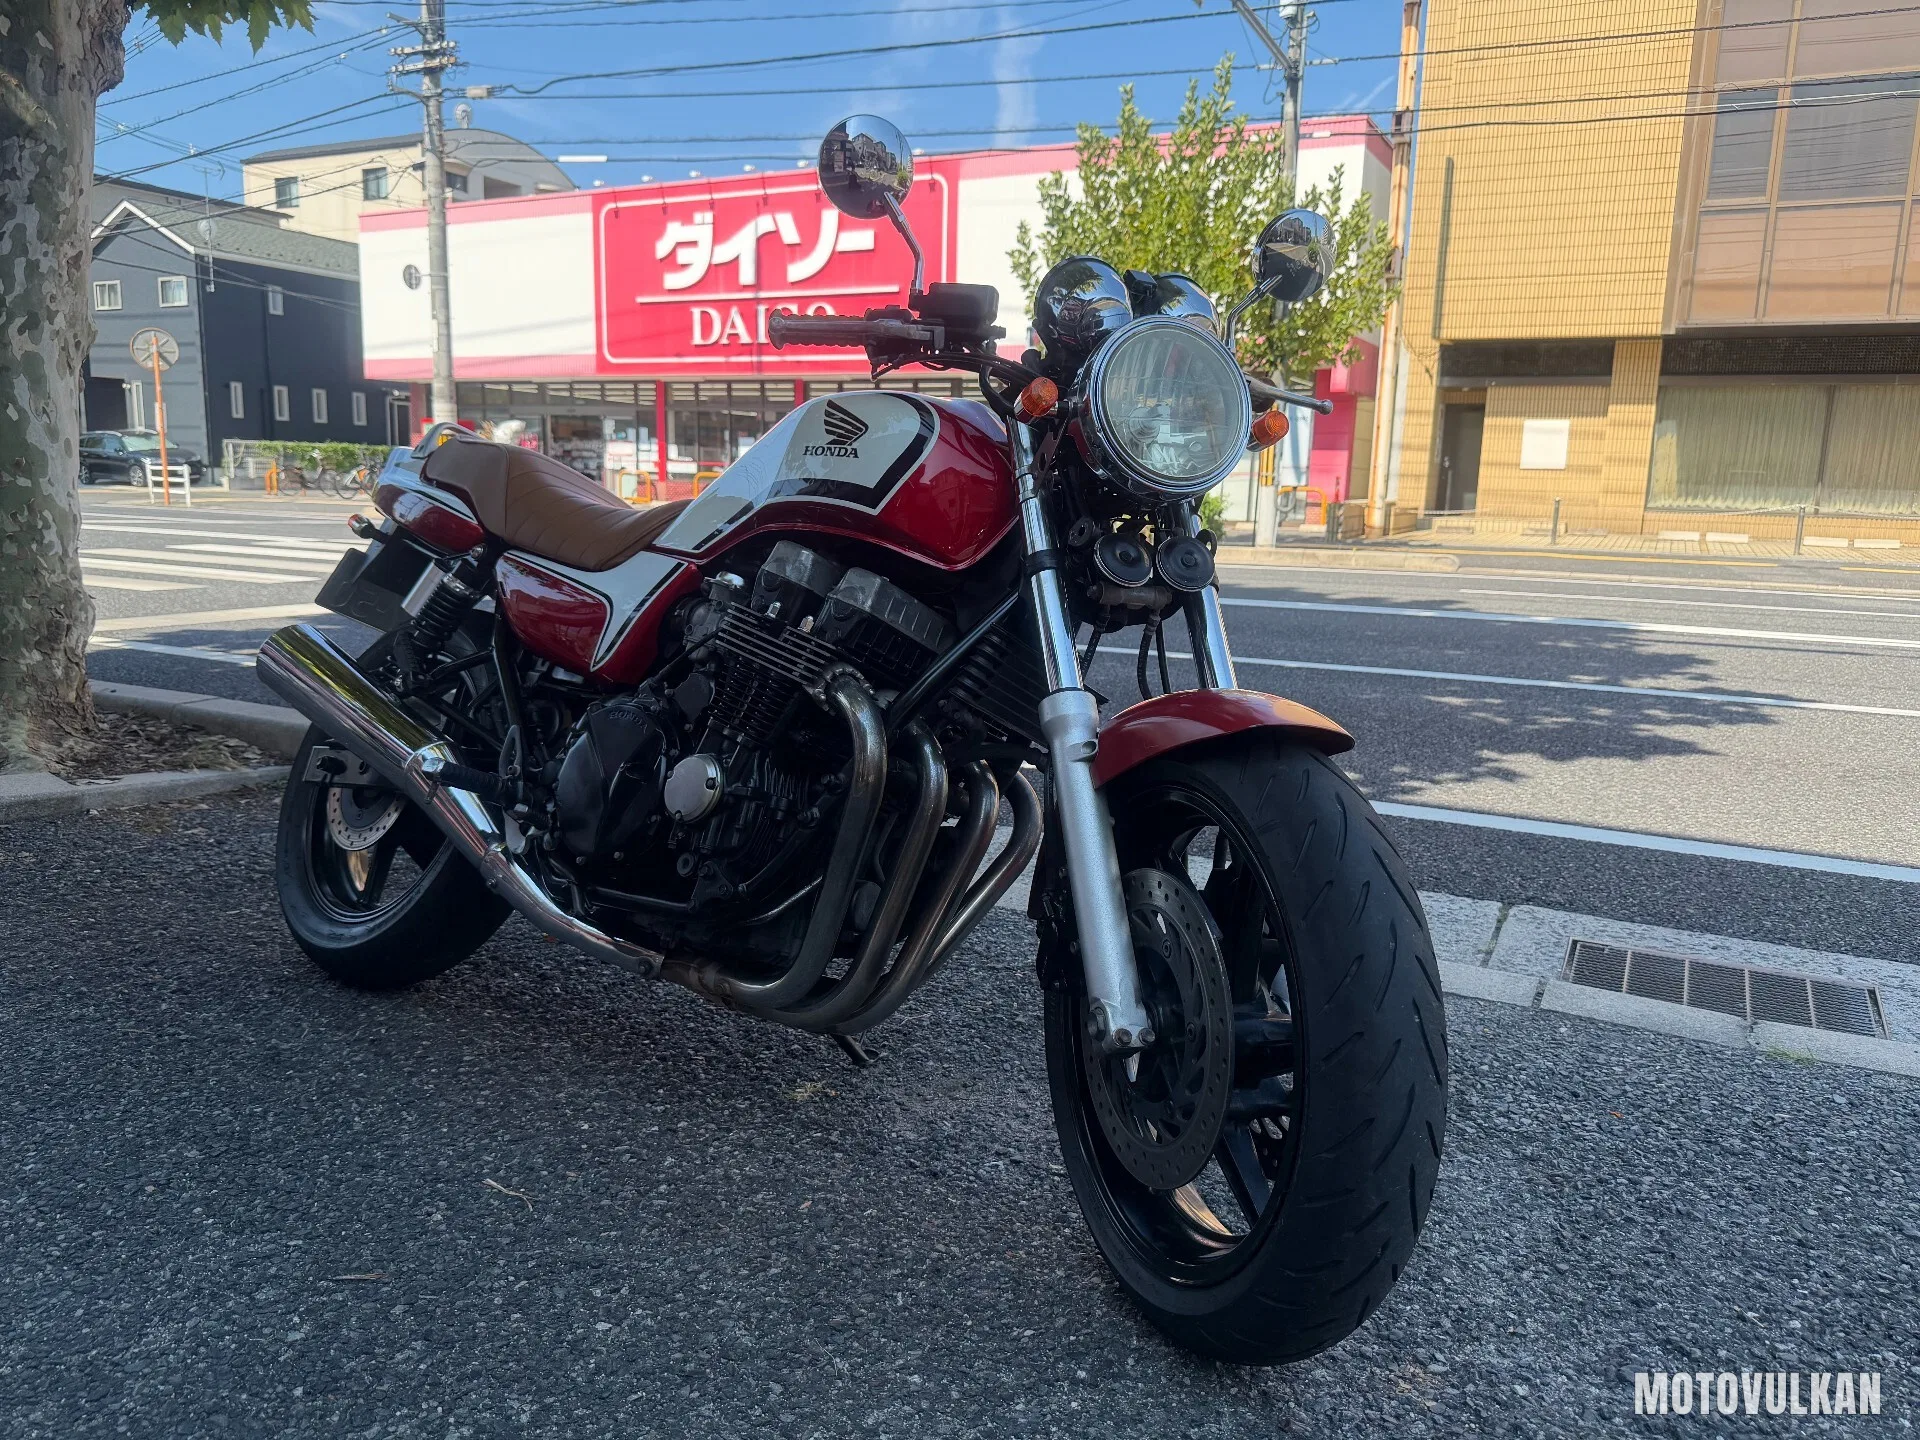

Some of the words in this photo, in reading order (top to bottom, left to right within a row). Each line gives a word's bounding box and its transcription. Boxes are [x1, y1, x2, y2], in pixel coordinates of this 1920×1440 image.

[655, 209, 875, 289] ダイソー
[690, 302, 837, 346] DAI
[803, 446, 859, 458] HONDA
